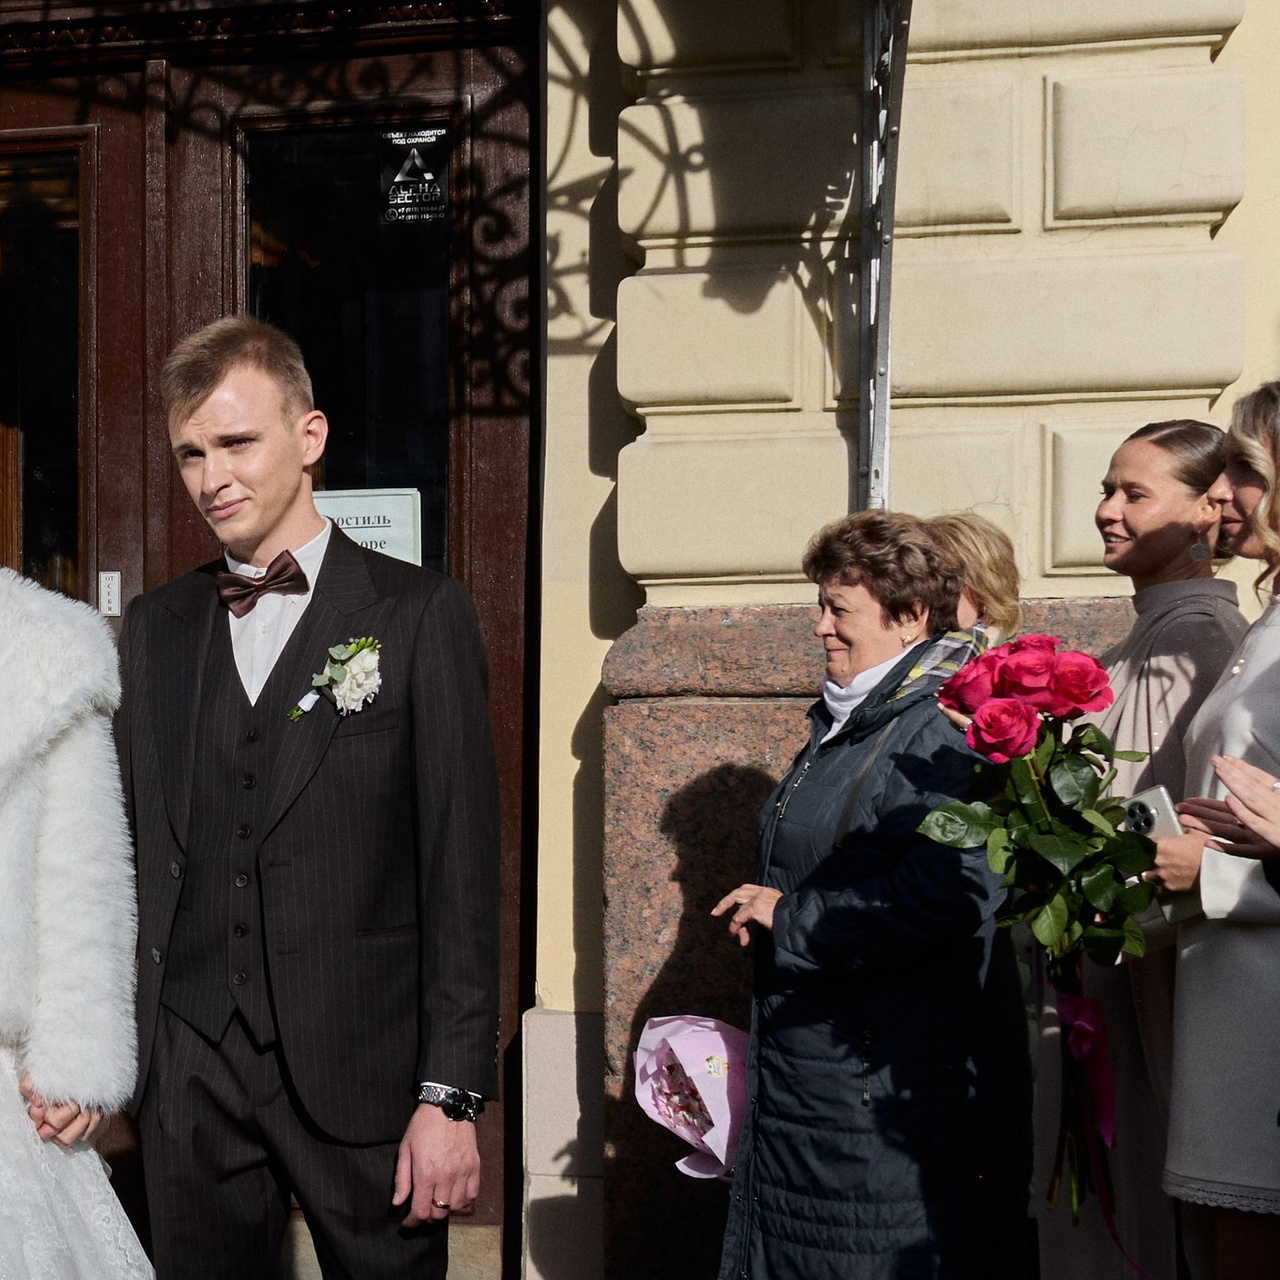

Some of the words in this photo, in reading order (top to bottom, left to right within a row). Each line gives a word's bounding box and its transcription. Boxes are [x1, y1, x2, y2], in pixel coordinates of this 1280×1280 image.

[388, 183, 441, 194] ALPHA
[388, 192, 441, 204] SECTOR
[334, 515, 391, 526] остиль
